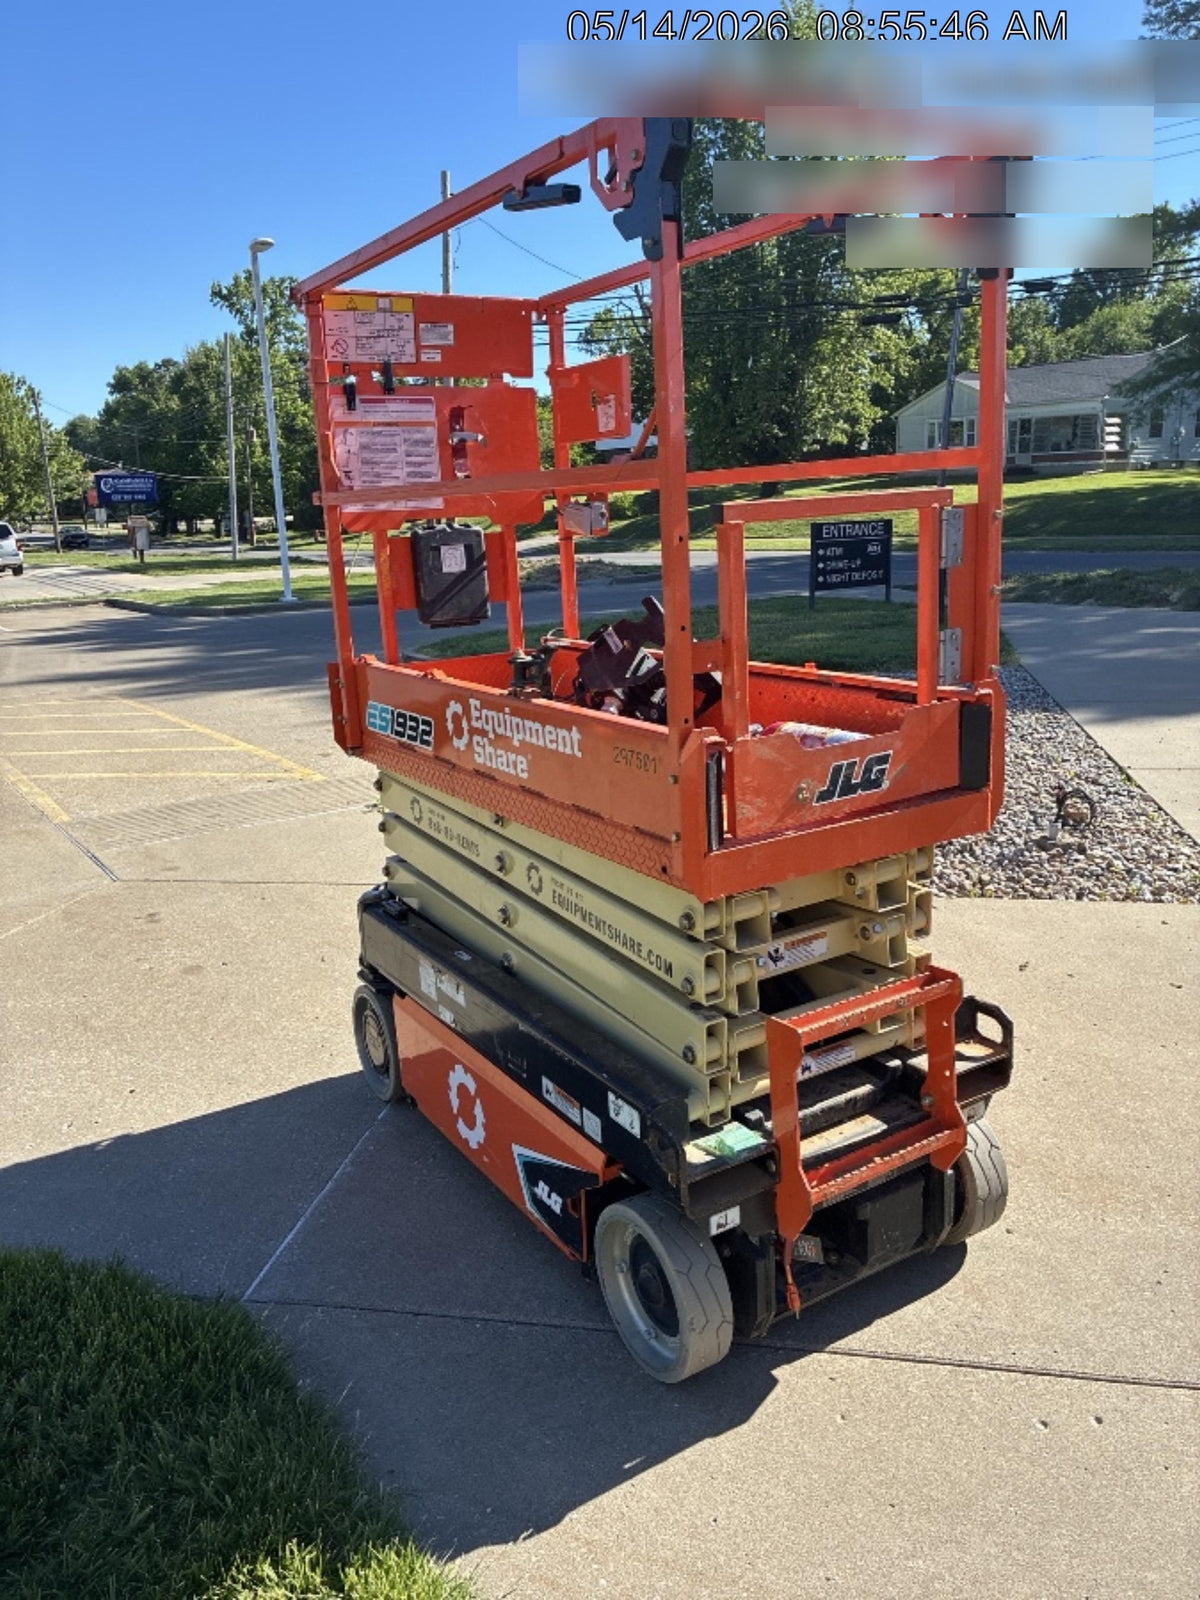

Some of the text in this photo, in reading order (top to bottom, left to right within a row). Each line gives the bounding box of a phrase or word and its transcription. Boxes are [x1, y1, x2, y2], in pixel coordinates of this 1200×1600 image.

[822, 522, 885, 538] ENTRANCE
[367, 700, 434, 750] ES1932
[468, 698, 583, 758] Equipment
[472, 735, 529, 779] Share
[812, 750, 893, 806] JLG
[552, 888, 673, 979] EQUIPMENTSHARE.COM
